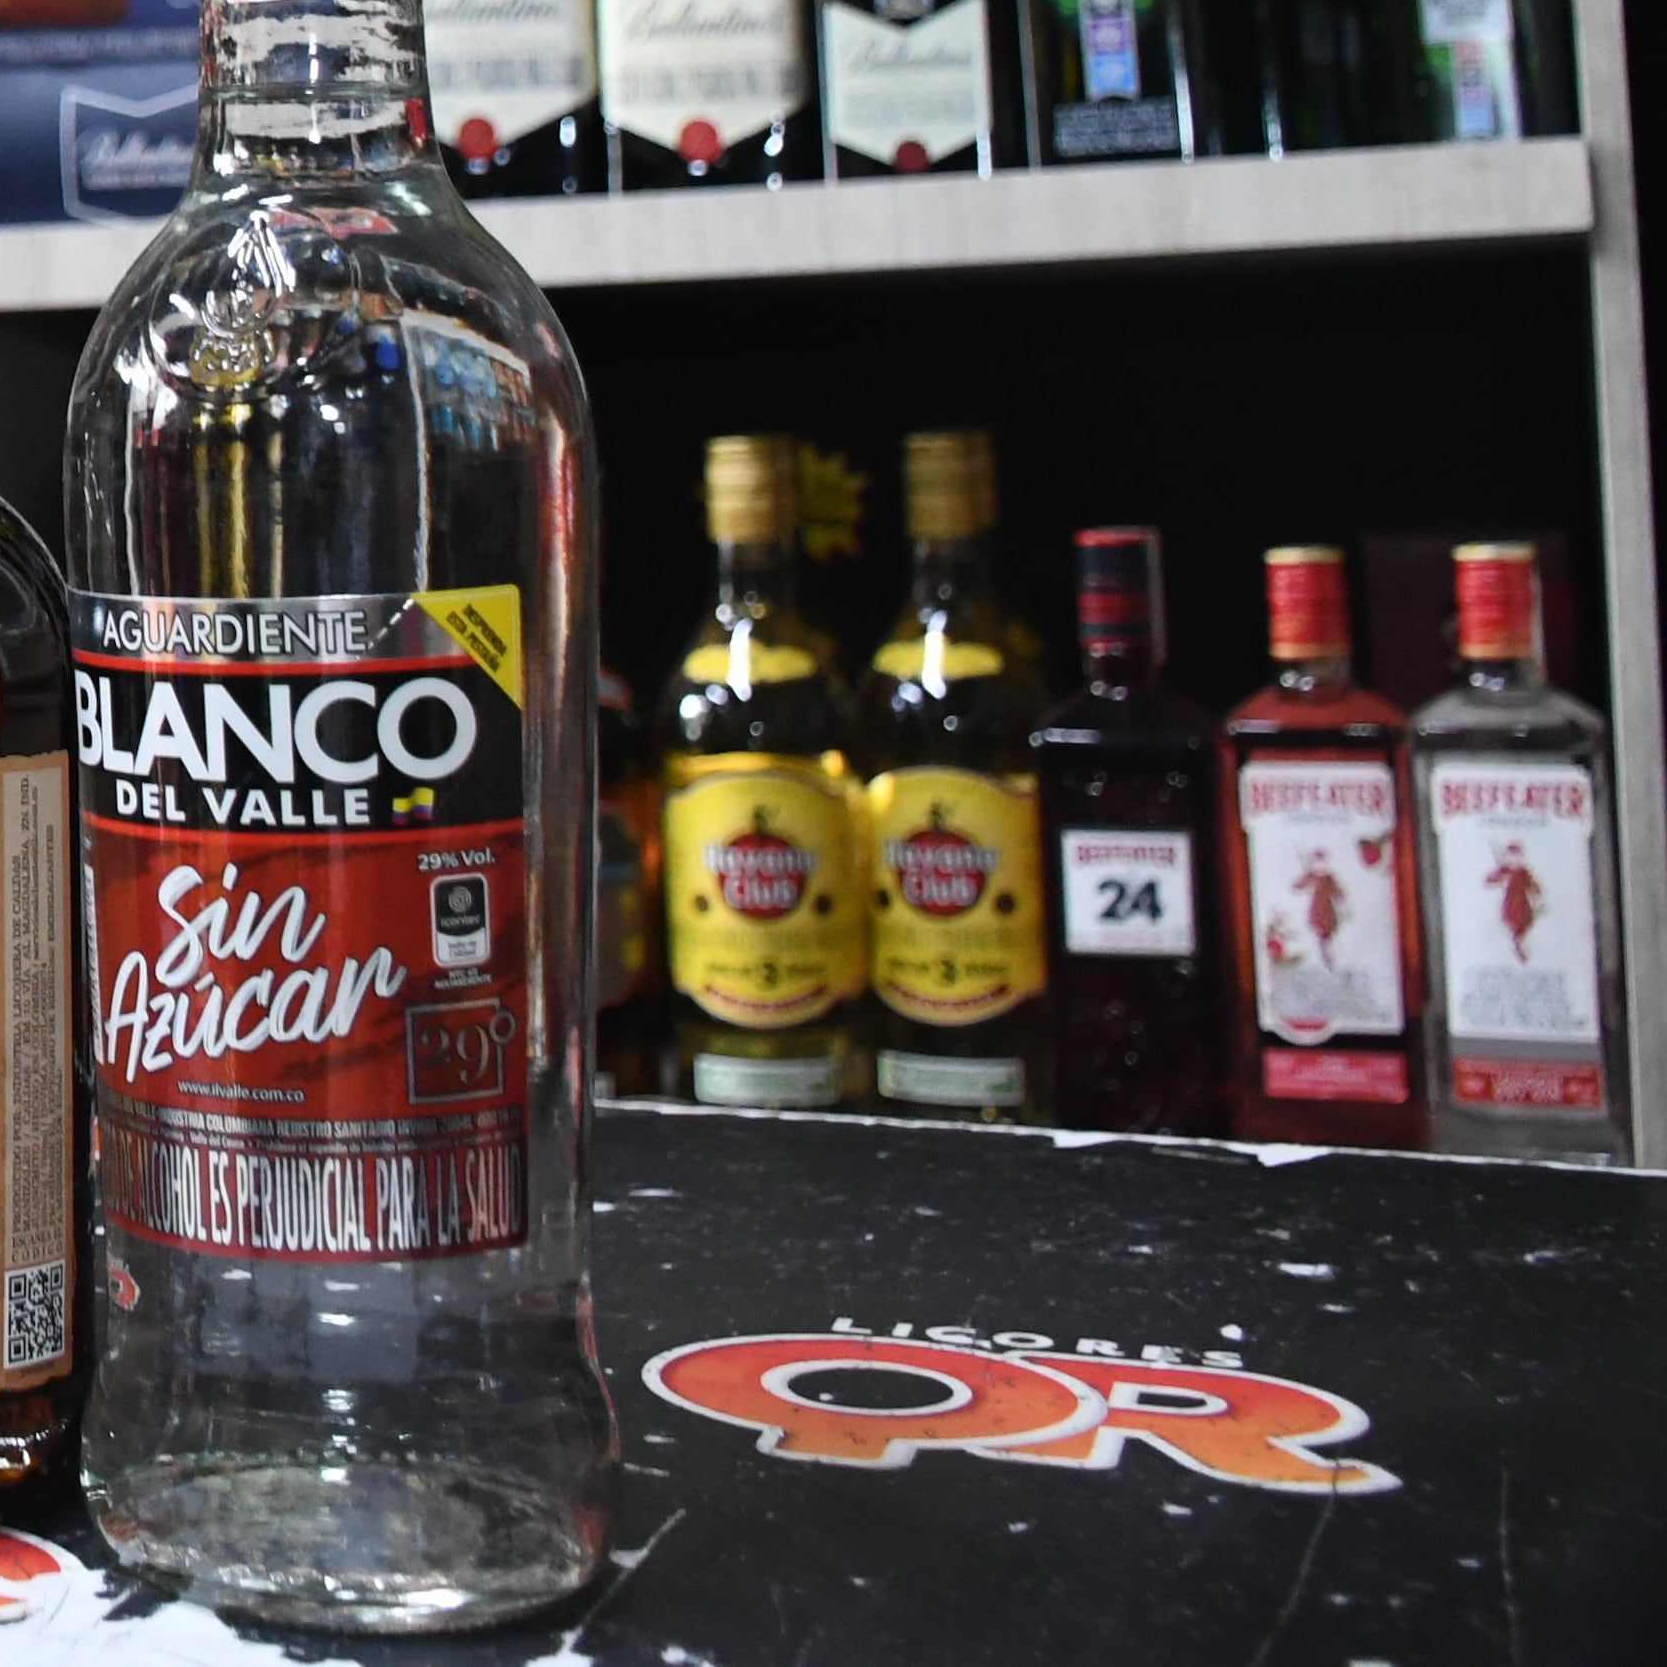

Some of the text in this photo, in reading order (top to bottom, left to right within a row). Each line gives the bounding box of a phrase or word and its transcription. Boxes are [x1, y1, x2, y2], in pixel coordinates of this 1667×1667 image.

[103, 610, 366, 654] AGUARDIENTE
[74, 668, 478, 784] BLANCO
[115, 778, 369, 826] DEL VALLE
[1249, 780, 1386, 816] BEEFEATER
[1440, 780, 1586, 818] BEEFEATER
[417, 847, 495, 871] 29% Vol.
[1098, 878, 1163, 924] 24
[154, 863, 326, 988] Sin
[104, 945, 407, 1083] Azúcar
[12, 854, 23, 1234] PRODUCIDO POR INDUSTRIA LICORERA DE CALDAS
[177, 1080, 305, 1103] www.ilvalle.com.co
[334, 1119, 396, 1139] SANITARIO
[136, 1134, 522, 1253] ALCOHOL ES PERJUDICIAL PARA LA SALUD
[830, 1317, 1245, 1368] LICORES
